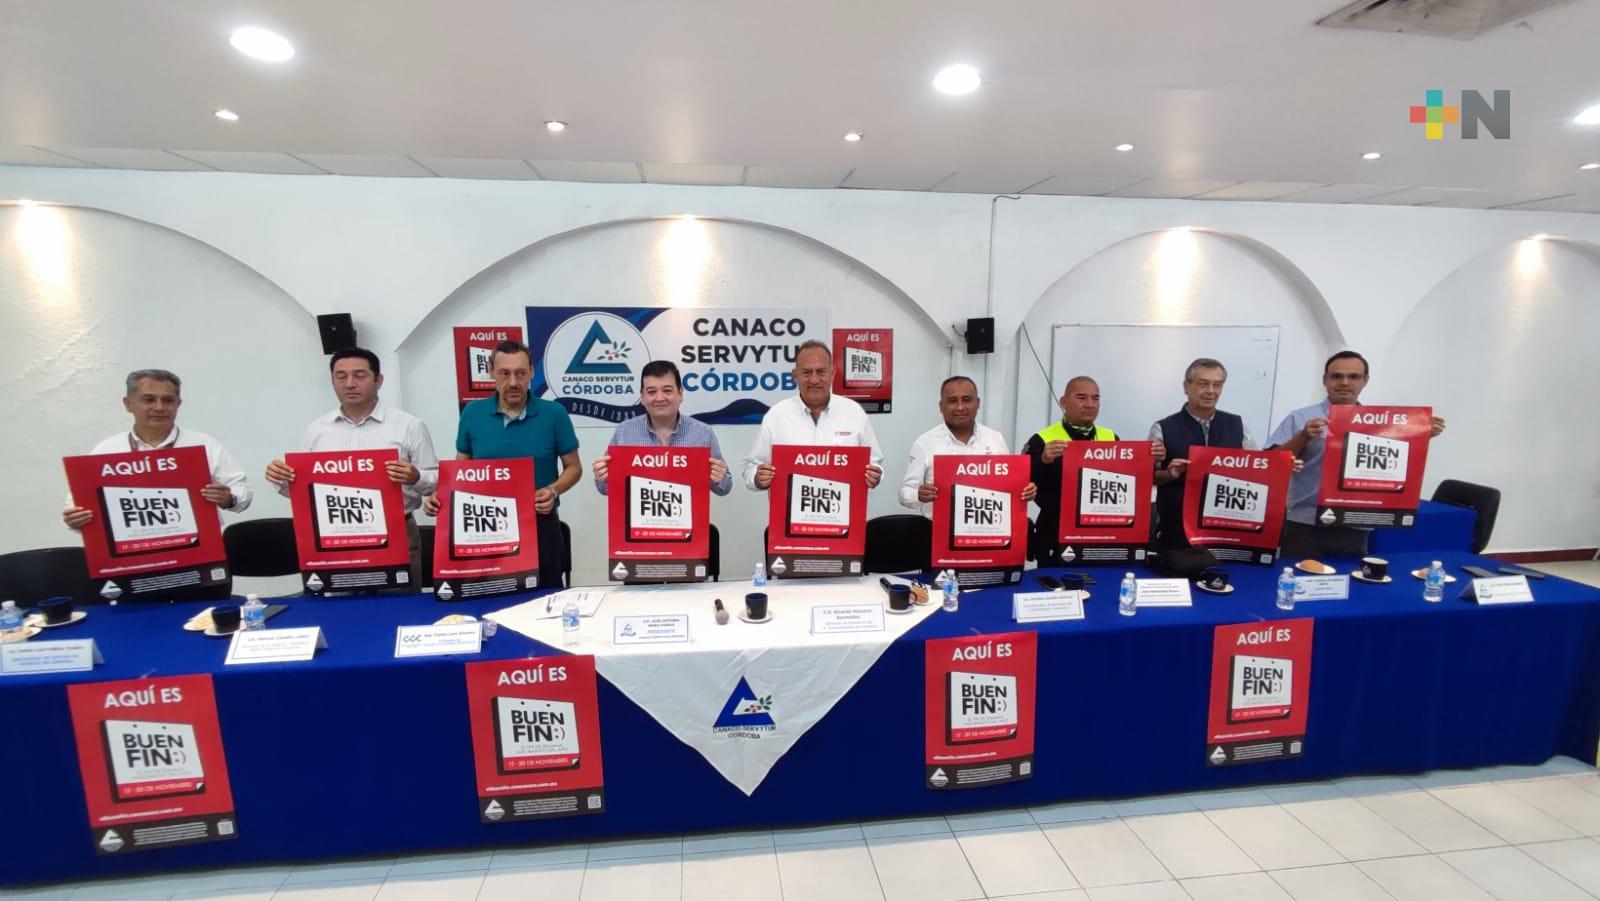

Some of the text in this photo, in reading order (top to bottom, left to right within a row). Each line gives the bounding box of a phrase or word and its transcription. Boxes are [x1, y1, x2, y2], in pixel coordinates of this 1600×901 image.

[692, 318, 806, 337] CANACO
[470, 330, 507, 342] AQUÍ ES
[847, 331, 869, 342] AQUÍ
[477, 354, 491, 363] BU
[681, 345, 800, 363] SERVYTU
[851, 354, 877, 365] BUEN
[682, 367, 797, 392] CÓRDOB
[562, 382, 634, 395] CÓRDOBA
[572, 402, 606, 417] DESDE
[1351, 410, 1408, 425] AQUÍ ES
[1083, 445, 1134, 460] AQUÍ ES
[1357, 442, 1399, 458] BUEN
[102, 456, 178, 477] AQUÍ ES
[312, 456, 374, 474] AQUÍ ES
[631, 451, 688, 469] AQUÍ ES
[794, 450, 849, 467] AQUÍ ES
[1211, 454, 1269, 469] AQUÍ ES
[455, 465, 511, 482] AQUÍ ES
[956, 459, 1008, 476] AQUÍ ES
[801, 485, 841, 501] BUEN
[1090, 478, 1128, 493] BUEN
[1216, 484, 1258, 501] BUEN
[326, 495, 373, 510] BUEN
[640, 488, 682, 505] BUEN
[964, 496, 1003, 511] BUEN
[119, 498, 180, 512] BUEN
[462, 502, 508, 518] BUEN
[1236, 626, 1291, 646] AQUÍ ES
[952, 641, 1013, 662] AQUÍ ES
[497, 663, 568, 686] AQUÍ ES
[1243, 666, 1283, 681] BUEN
[104, 685, 183, 709] AQUÍ ES
[961, 683, 1007, 698] BUEN
[510, 709, 565, 725] BUEN
[122, 733, 184, 749] BUEN
